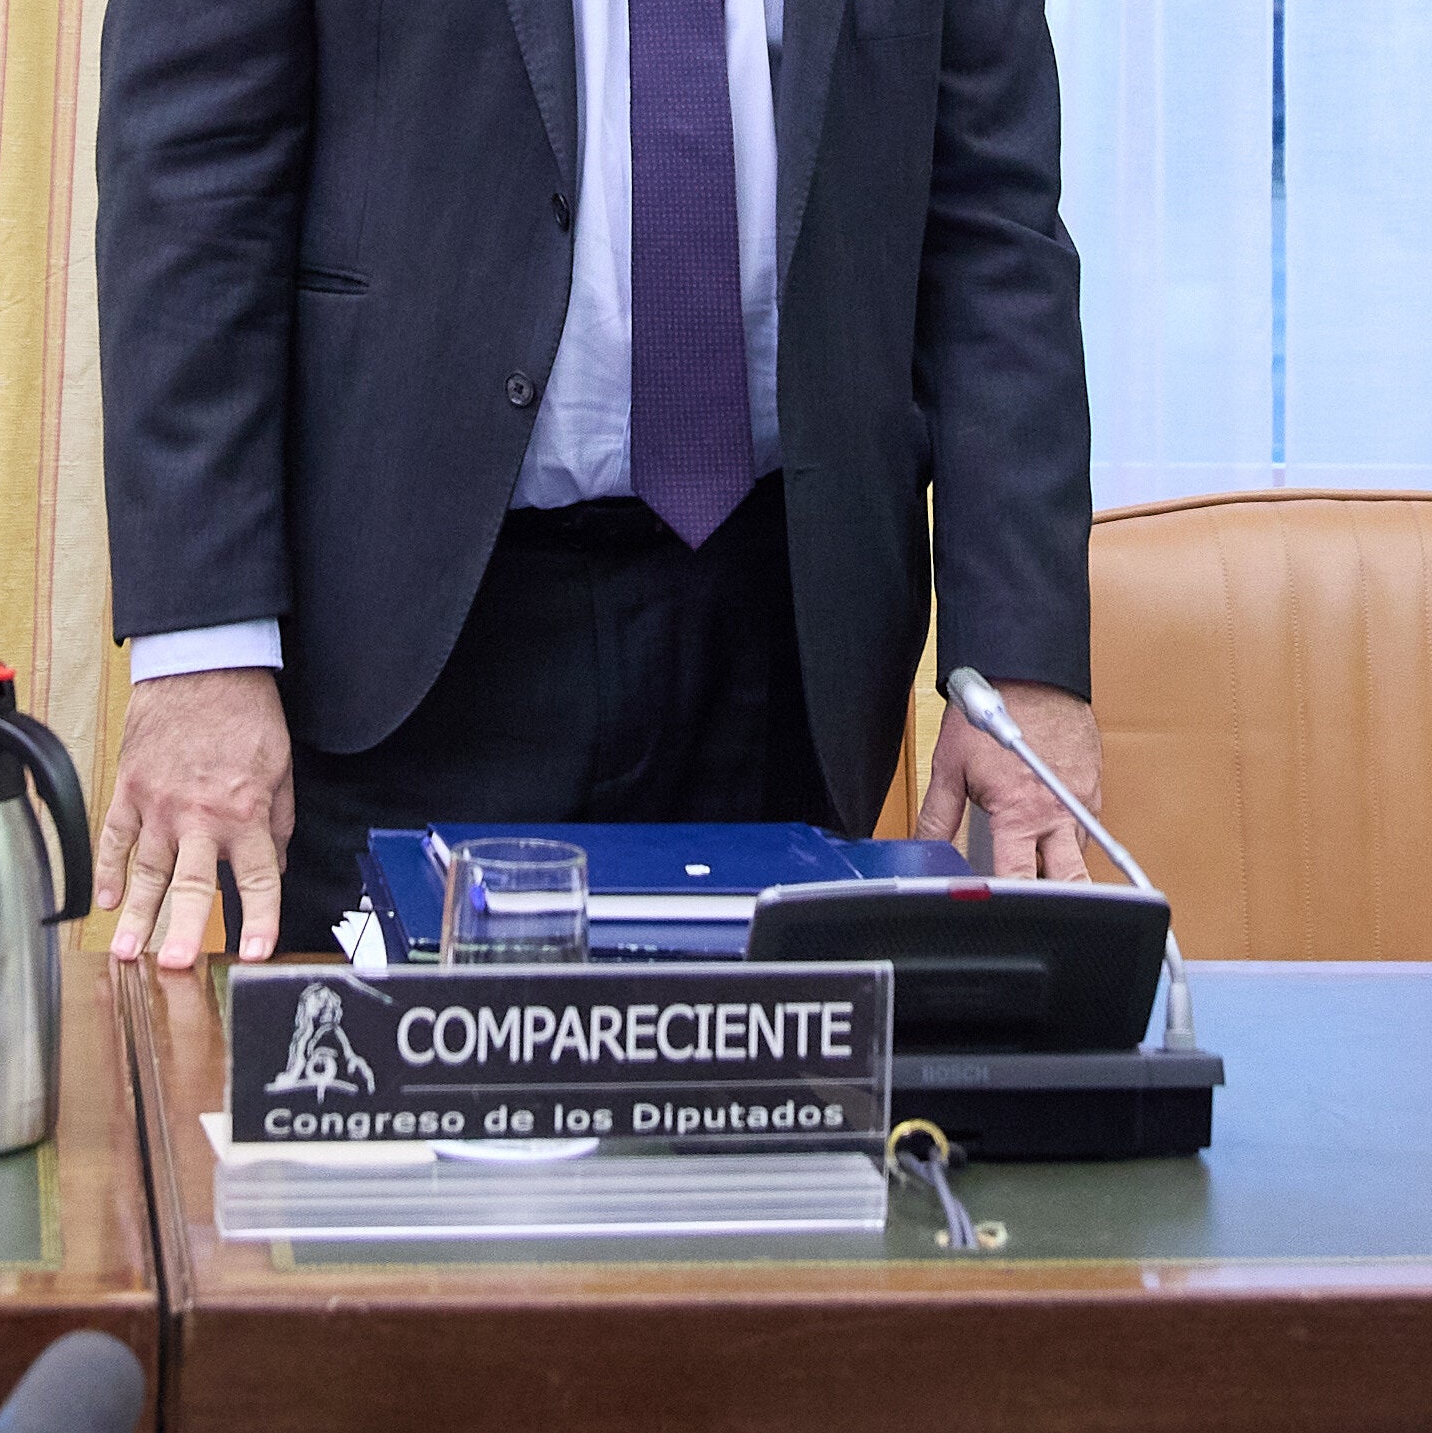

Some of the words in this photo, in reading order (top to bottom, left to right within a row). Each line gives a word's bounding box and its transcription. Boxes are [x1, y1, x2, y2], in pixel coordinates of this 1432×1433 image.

[396, 1001, 854, 1066] COMPARECIENTE
[264, 1107, 466, 1141] Congreso
[483, 1103, 535, 1134] de
[554, 1103, 614, 1133] los
[632, 1099, 845, 1136] Diputados
